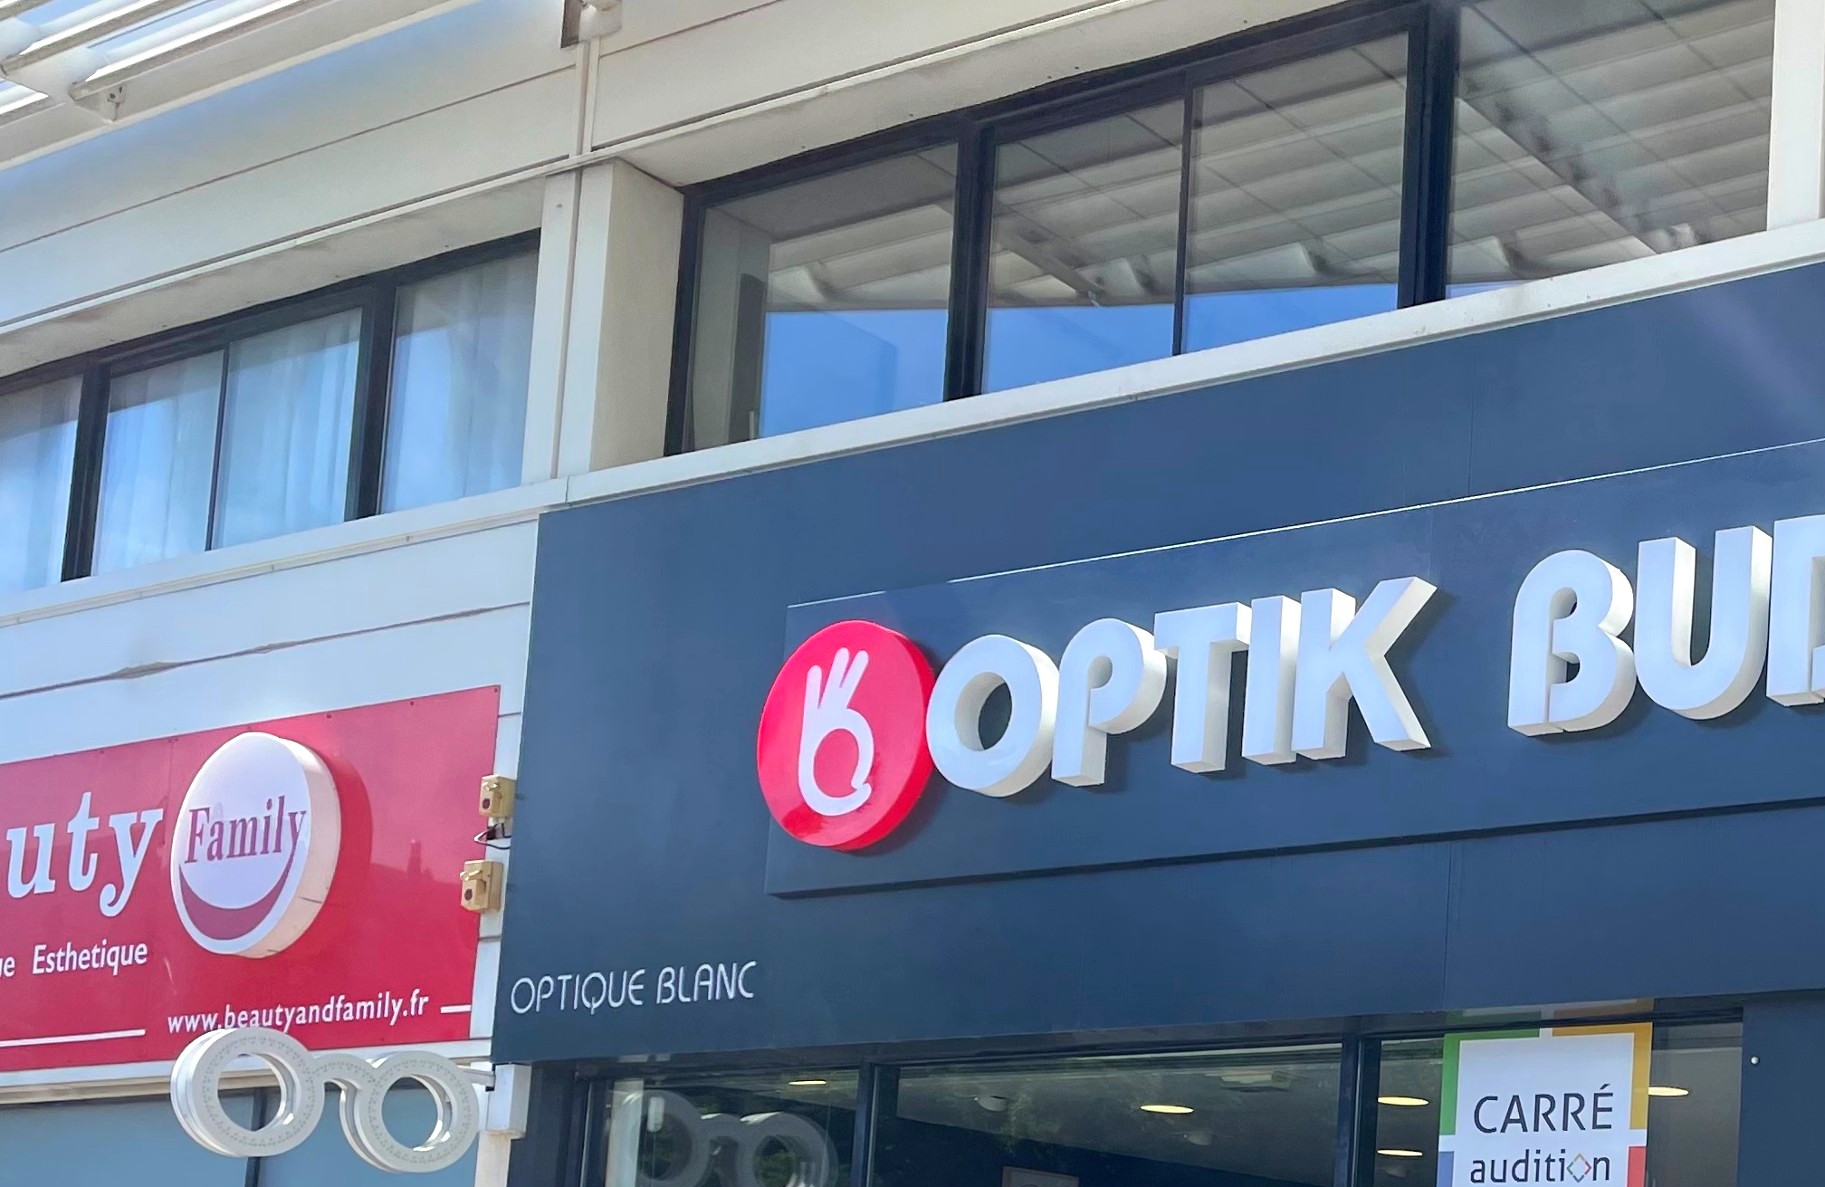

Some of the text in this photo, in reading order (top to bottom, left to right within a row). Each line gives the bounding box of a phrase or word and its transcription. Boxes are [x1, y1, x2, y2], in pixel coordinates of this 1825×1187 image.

[926, 577, 1437, 797] OPTIK
[184, 796, 307, 864] Family
[32, 938, 148, 976] Esthetique
[168, 988, 429, 1034] www.beautyandfamily.fr
[511, 961, 757, 1014] OPTIQUE BLANC
[1474, 1083, 1614, 1133] CARRÉ
